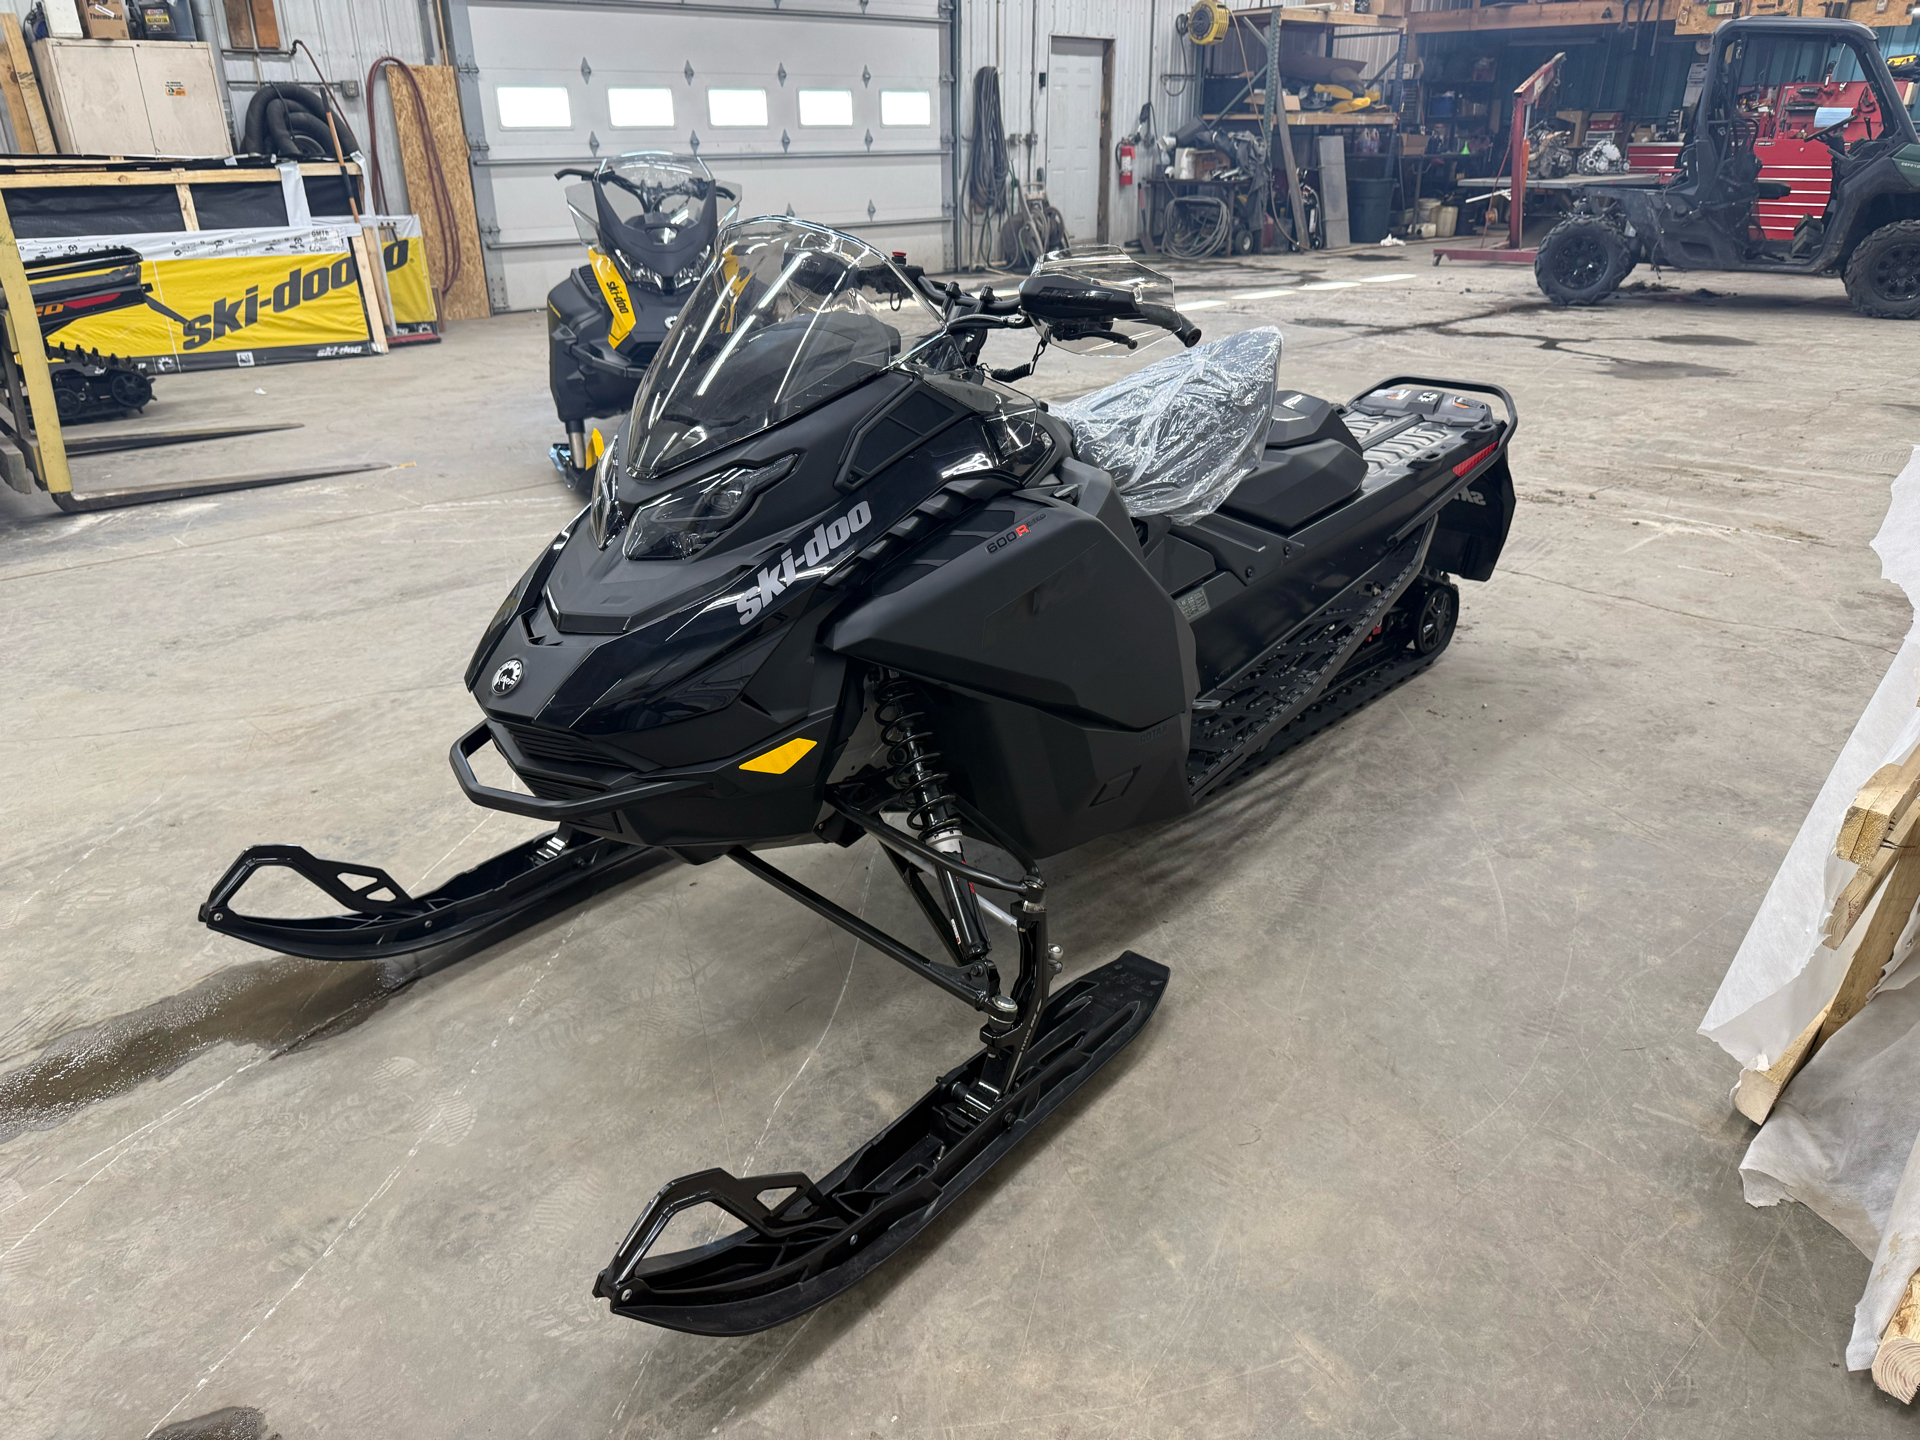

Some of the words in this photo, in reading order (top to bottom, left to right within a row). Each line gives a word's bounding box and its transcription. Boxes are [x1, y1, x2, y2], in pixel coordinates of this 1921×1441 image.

[182, 256, 357, 351] ski-doo
[606, 281, 629, 314] ski-doo
[316, 344, 363, 357] ski-doo
[986, 524, 1030, 554] 600R
[736, 500, 872, 626] ski-doo
